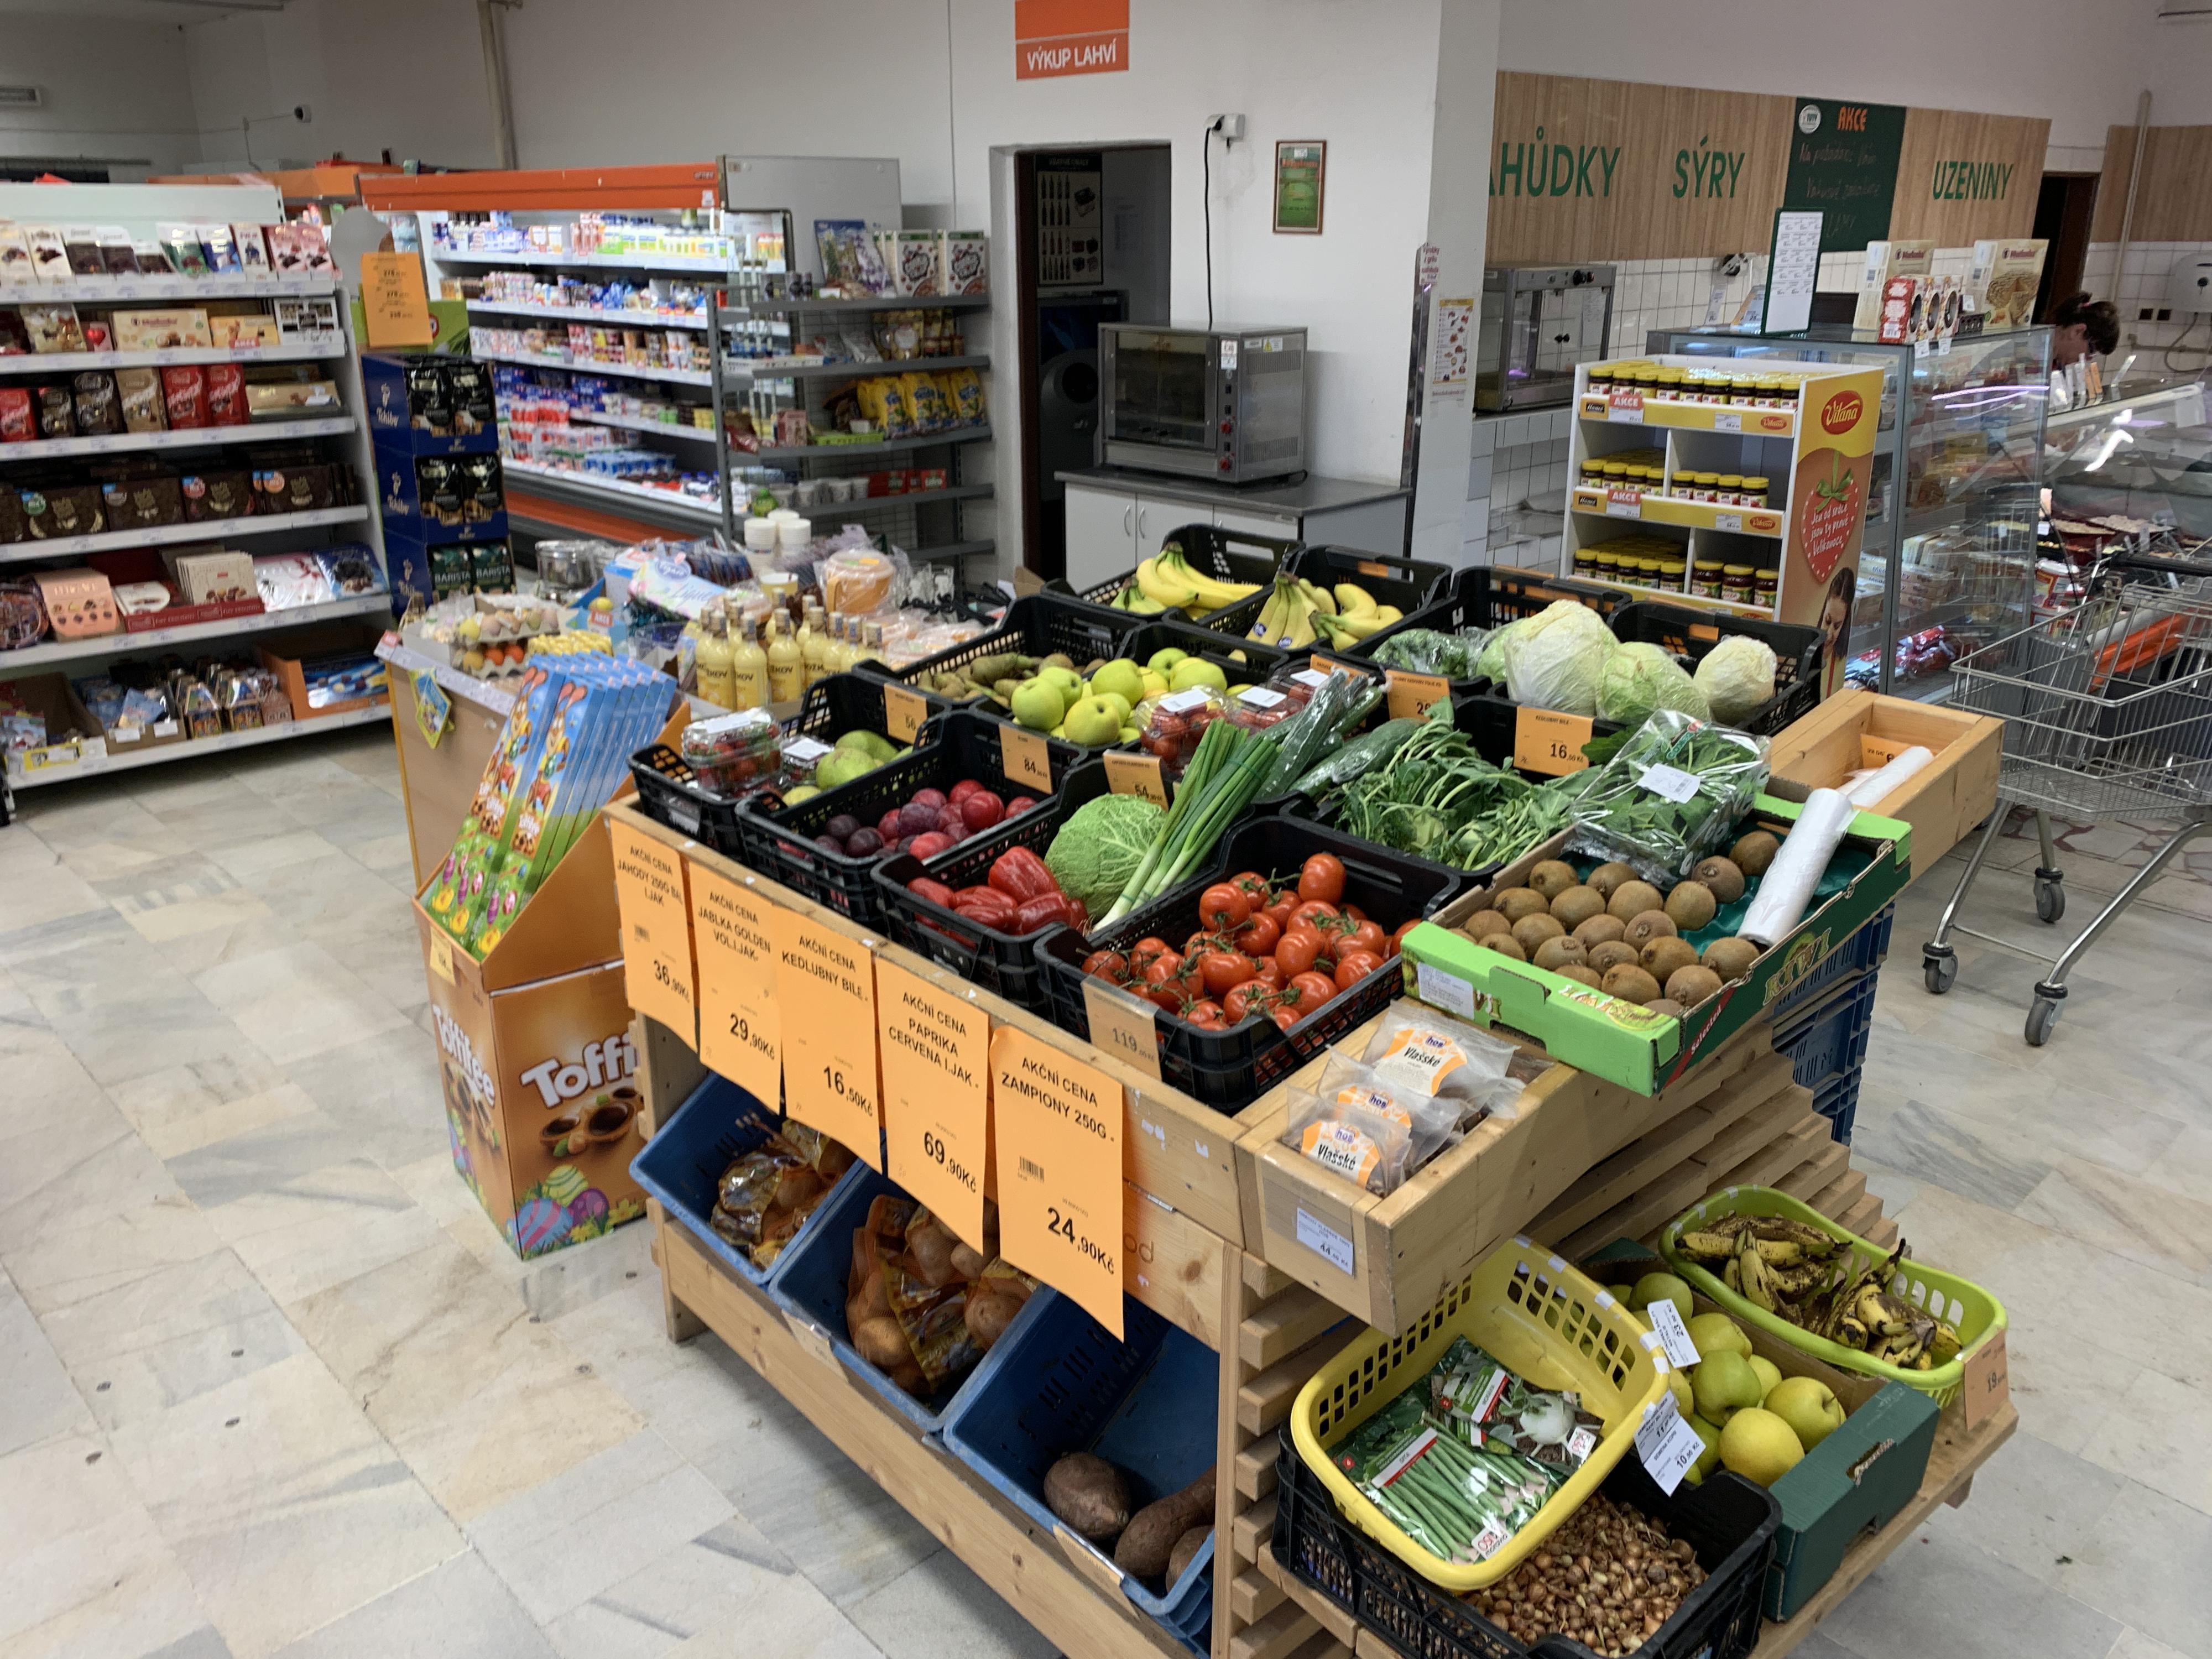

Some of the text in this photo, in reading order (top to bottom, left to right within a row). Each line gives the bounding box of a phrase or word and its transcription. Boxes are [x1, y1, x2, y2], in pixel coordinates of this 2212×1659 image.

[1027, 38, 1117, 71] VÝKUP LAHVÍ
[1837, 106, 1868, 132] AKCE
[1673, 134, 1745, 198] SÝRY
[1933, 160, 2015, 201] UZENINY
[1614, 397, 1639, 408] AKCE
[1825, 399, 1858, 425] Vitana
[1763, 418, 1783, 428] Vitana
[1612, 491, 1637, 502] AKCE
[1752, 517, 1773, 528] Vitana
[1811, 514, 1850, 543] jsou ty pravé
[1812, 502, 1848, 525] Jen od srdce
[1812, 535, 1843, 557] Velikonoce
[398, 580, 415, 597] Tchib
[434, 572, 470, 583] BARISTA
[617, 859, 649, 883] JAHODY
[630, 844, 672, 875] AKČNÍ CENA
[709, 890, 759, 925] AKČNÍ CENA
[698, 906, 770, 953] JABLKA GOLDEN
[799, 935, 856, 972] AKČNÍ CENA
[1762, 927, 1832, 1006] KIWI
[782, 951, 863, 1001] KEDLUBNY BILE
[902, 992, 966, 1037] AKČNÍ CENA
[1691, 1005, 1721, 1055] Selected
[889, 1026, 941, 1067] CERVENA
[909, 1018, 958, 1057] PAPRIKA
[432, 1004, 495, 1107] Toffifee
[520, 1030, 639, 1108] Toffi
[1403, 1046, 1441, 1068] Vlašské
[1022, 1057, 1098, 1107] AKČNÍ CENA
[1001, 1071, 1107, 1140] ZAMPIONY 250G
[1317, 1144, 1356, 1171] Vlašské
